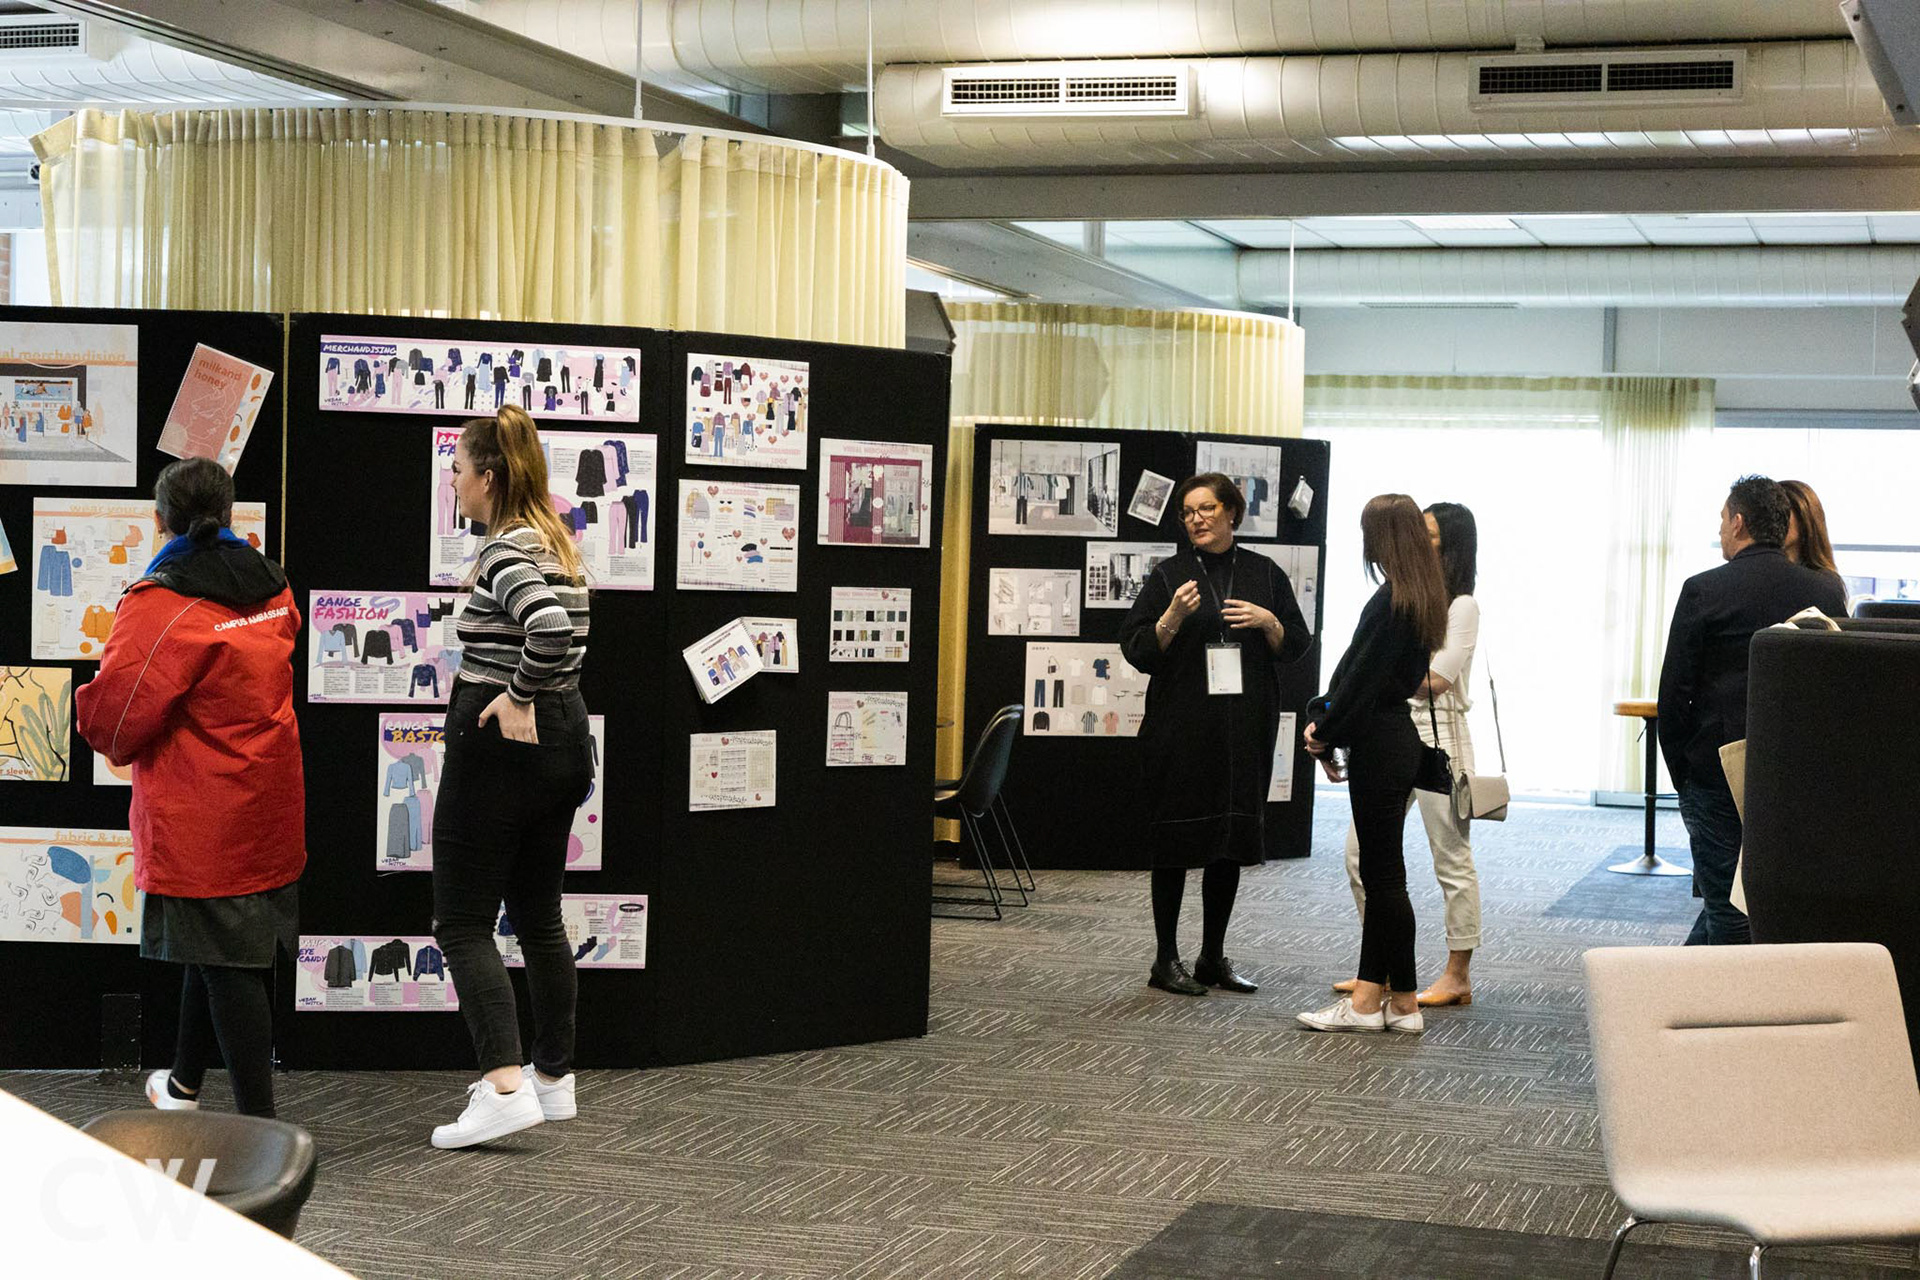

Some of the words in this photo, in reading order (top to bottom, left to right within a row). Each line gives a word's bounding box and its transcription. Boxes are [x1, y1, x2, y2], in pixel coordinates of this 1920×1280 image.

[323, 344, 397, 354] MERCHANDISING
[195, 369, 227, 390] honey
[316, 597, 362, 607] RANGE
[314, 606, 389, 620] FASHION
[214, 617, 248, 632] CAMPUS
[385, 720, 430, 731] RANGE
[6, 767, 34, 777] sleeve
[54, 830, 93, 842] fabric
[97, 832, 108, 842] &
[111, 833, 134, 845] tex
[299, 948, 315, 956] EYE
[298, 955, 327, 963] CANDY
